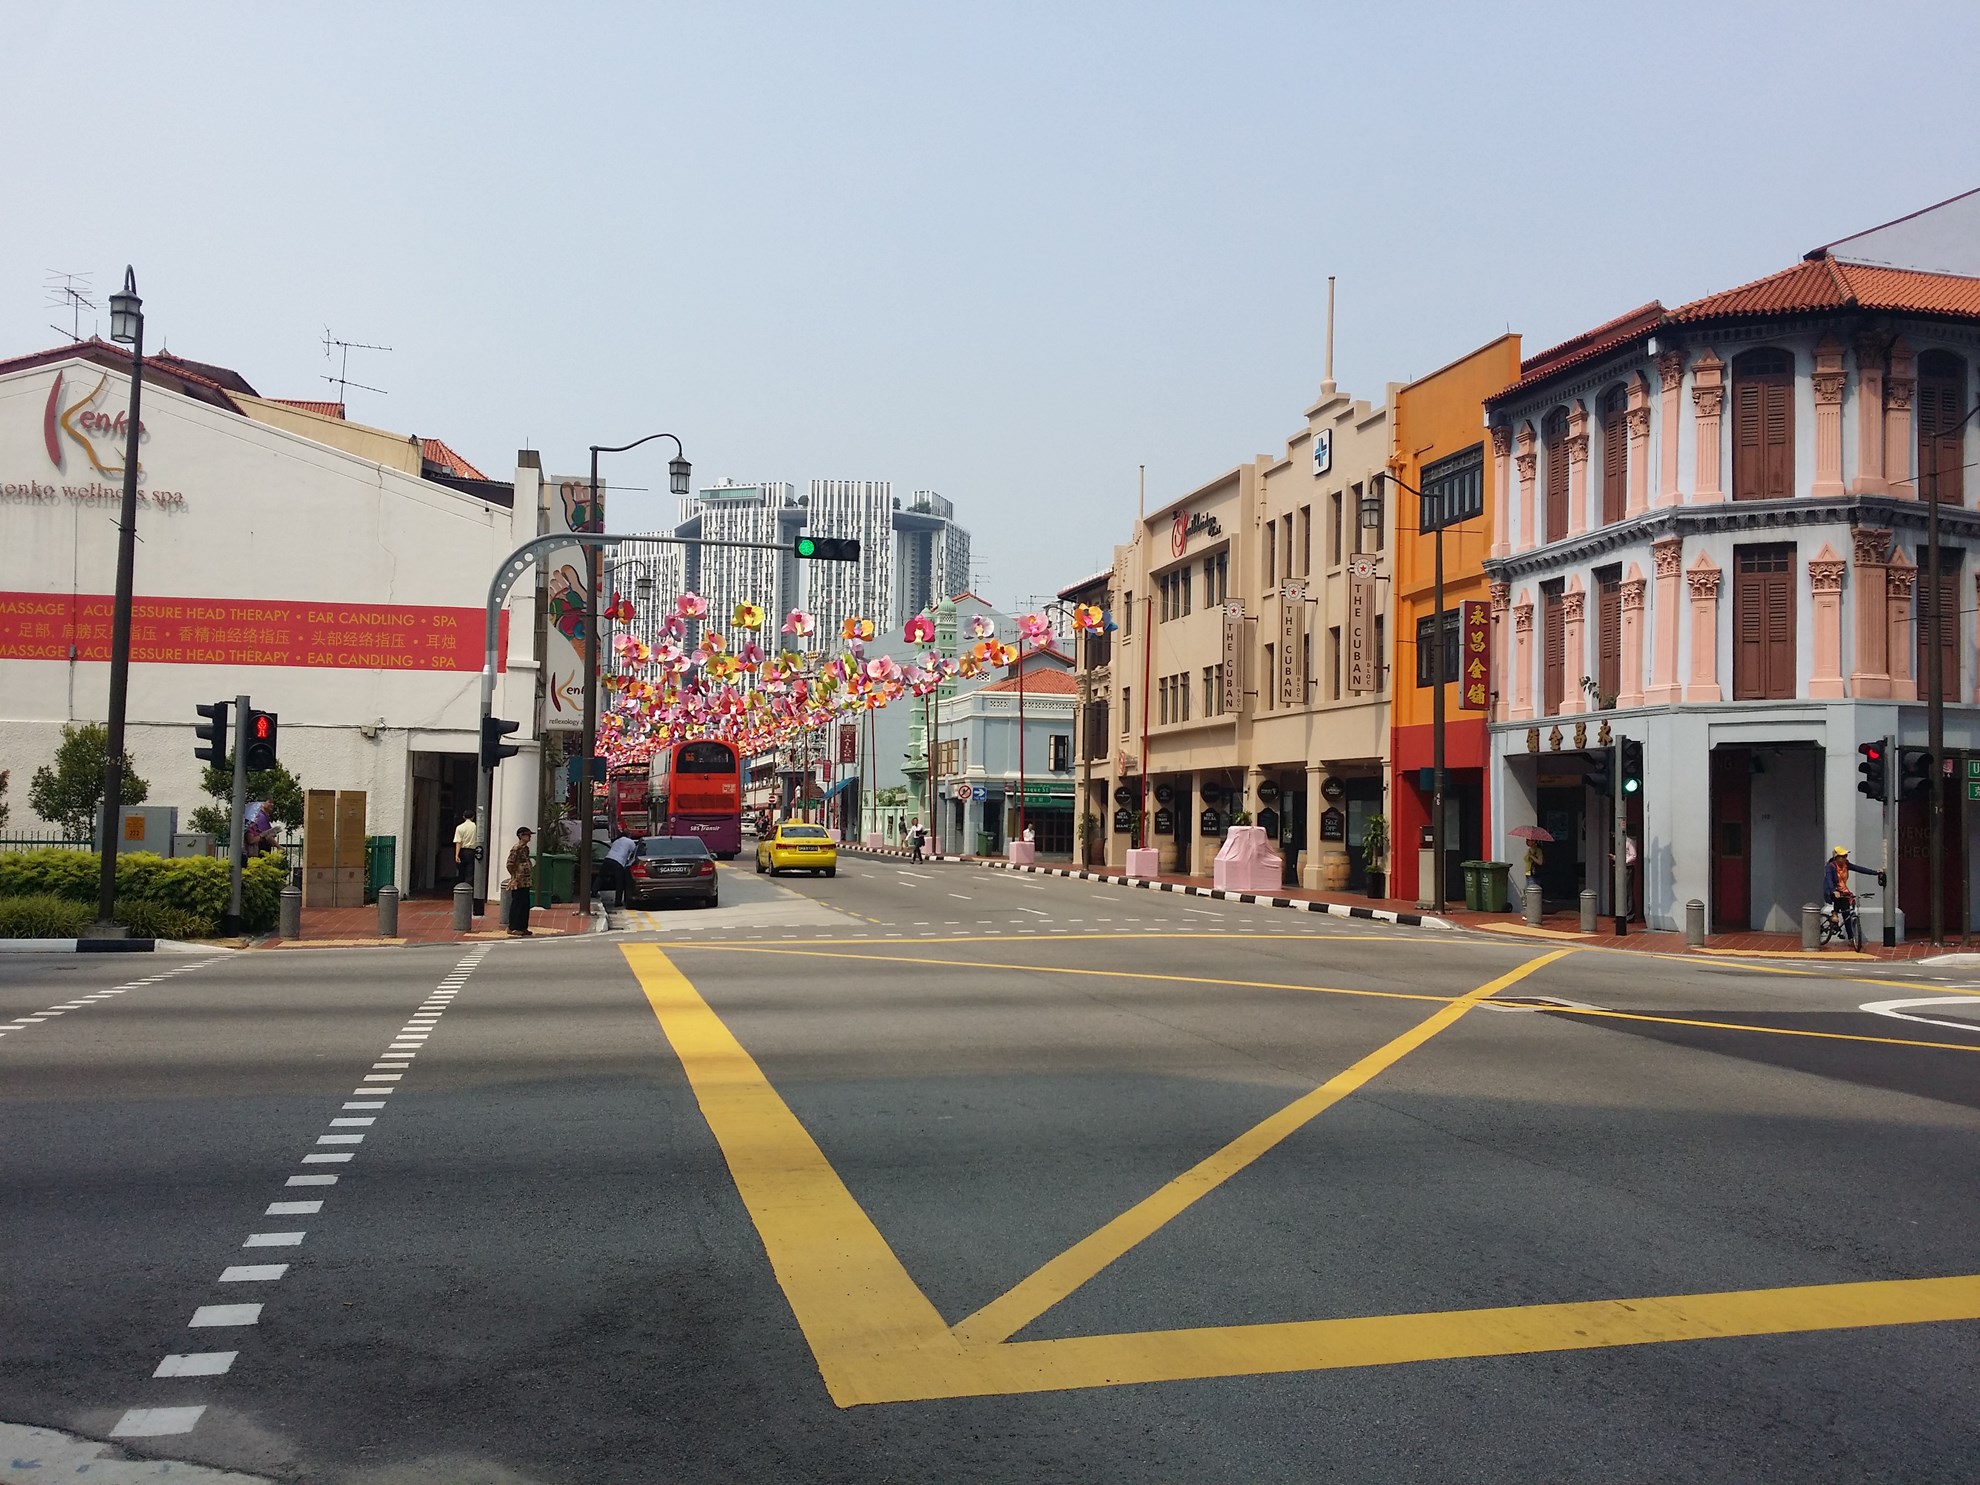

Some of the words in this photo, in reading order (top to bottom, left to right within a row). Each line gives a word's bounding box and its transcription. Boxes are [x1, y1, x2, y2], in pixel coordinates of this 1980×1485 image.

[0, 480, 55, 498] enko
[62, 483, 145, 500] wellnes
[152, 489, 184, 507] spa
[1353, 584, 1362, 617] THE
[83, 605, 181, 619] ACUESSURE
[186, 607, 226, 620] HEAD
[229, 608, 290, 622] THERAPY
[308, 611, 334, 624] EAR
[338, 612, 415, 626] CANDLING
[432, 616, 457, 628] SPA
[1285, 605, 1293, 636] THE
[311, 630, 406, 649] 头部经络指压
[426, 634, 457, 650] 耳烛
[83, 646, 181, 660] ACUESSURE
[186, 649, 226, 662] HEAD
[229, 650, 290, 664] THERAPY
[307, 652, 334, 665] EAR
[338, 653, 414, 667] CANDLING
[431, 655, 457, 668] SPA
[1284, 645, 1292, 697] CUBAN
[1352, 628, 1362, 685] CUBAN
[1225, 660, 1233, 708] CUBAN
[548, 718, 579, 727] reflexology
